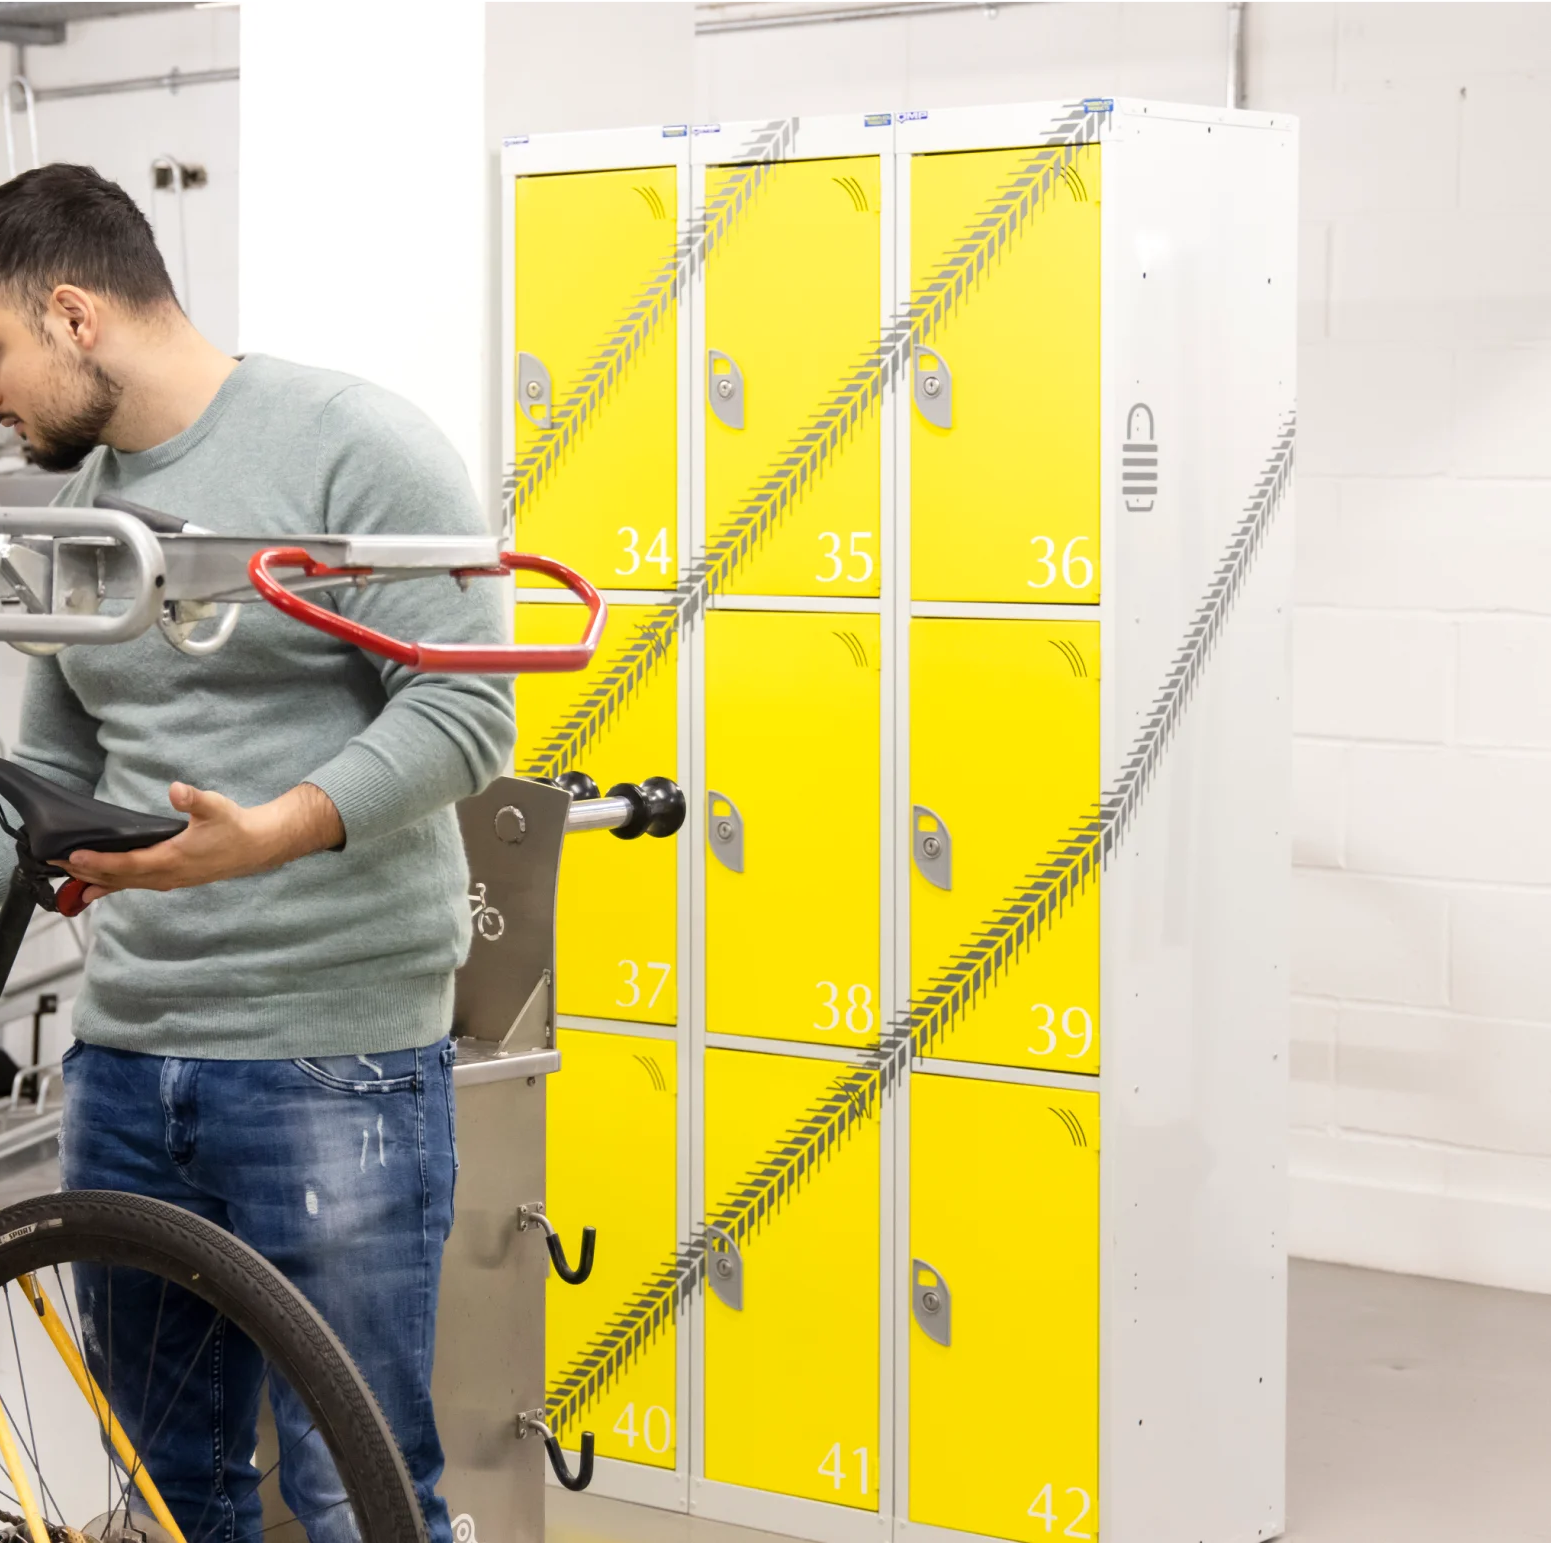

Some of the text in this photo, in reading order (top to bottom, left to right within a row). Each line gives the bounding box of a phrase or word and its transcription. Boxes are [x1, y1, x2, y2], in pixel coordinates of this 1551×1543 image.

[615, 526, 672, 575] 34
[815, 531, 873, 583] 35
[1027, 535, 1094, 589] 36
[614, 960, 672, 1008] 37
[812, 981, 874, 1035] 38
[1027, 1003, 1095, 1060] 39
[8, 1225, 34, 1241] SPORT
[613, 1403, 672, 1454] 40
[817, 1442, 871, 1495] 41
[1026, 1483, 1093, 1541] 42
